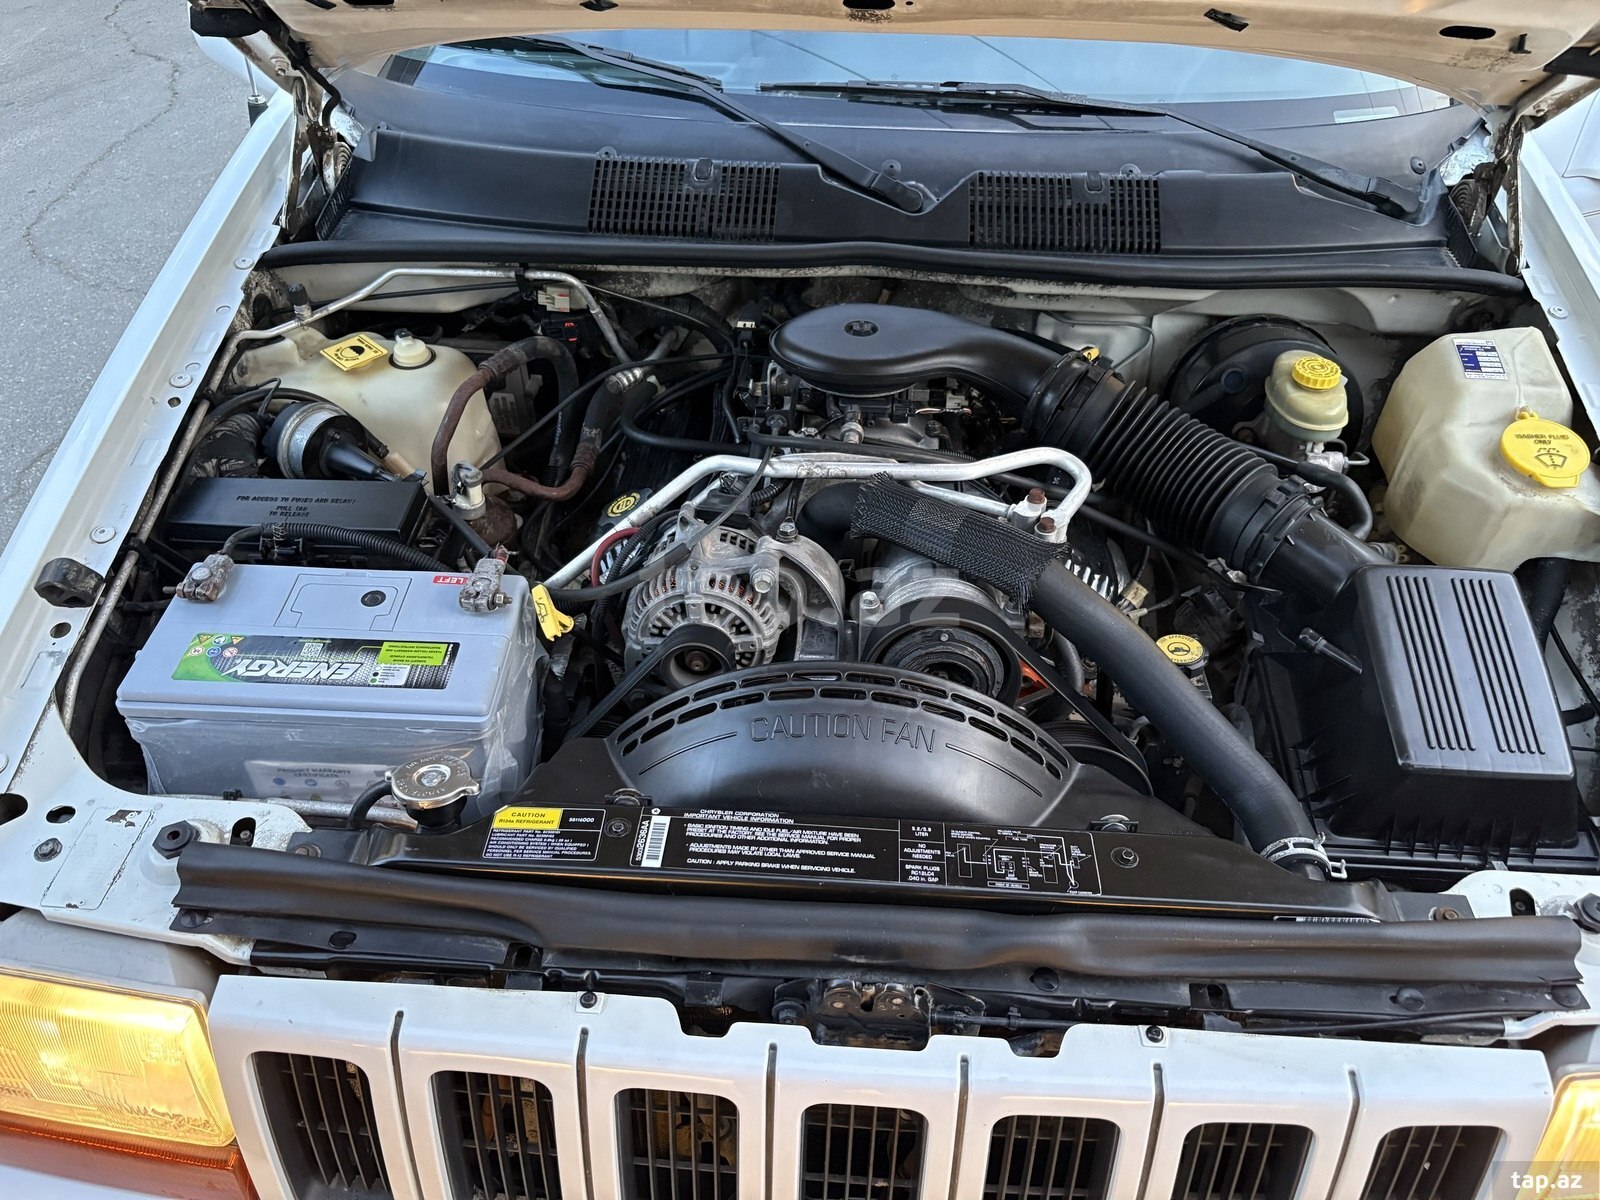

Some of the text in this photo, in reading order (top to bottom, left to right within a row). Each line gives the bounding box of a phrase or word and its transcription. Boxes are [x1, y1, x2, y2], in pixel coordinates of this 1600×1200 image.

[220, 658, 362, 680] ENERGY
[751, 713, 936, 753] CAUTION FAN
